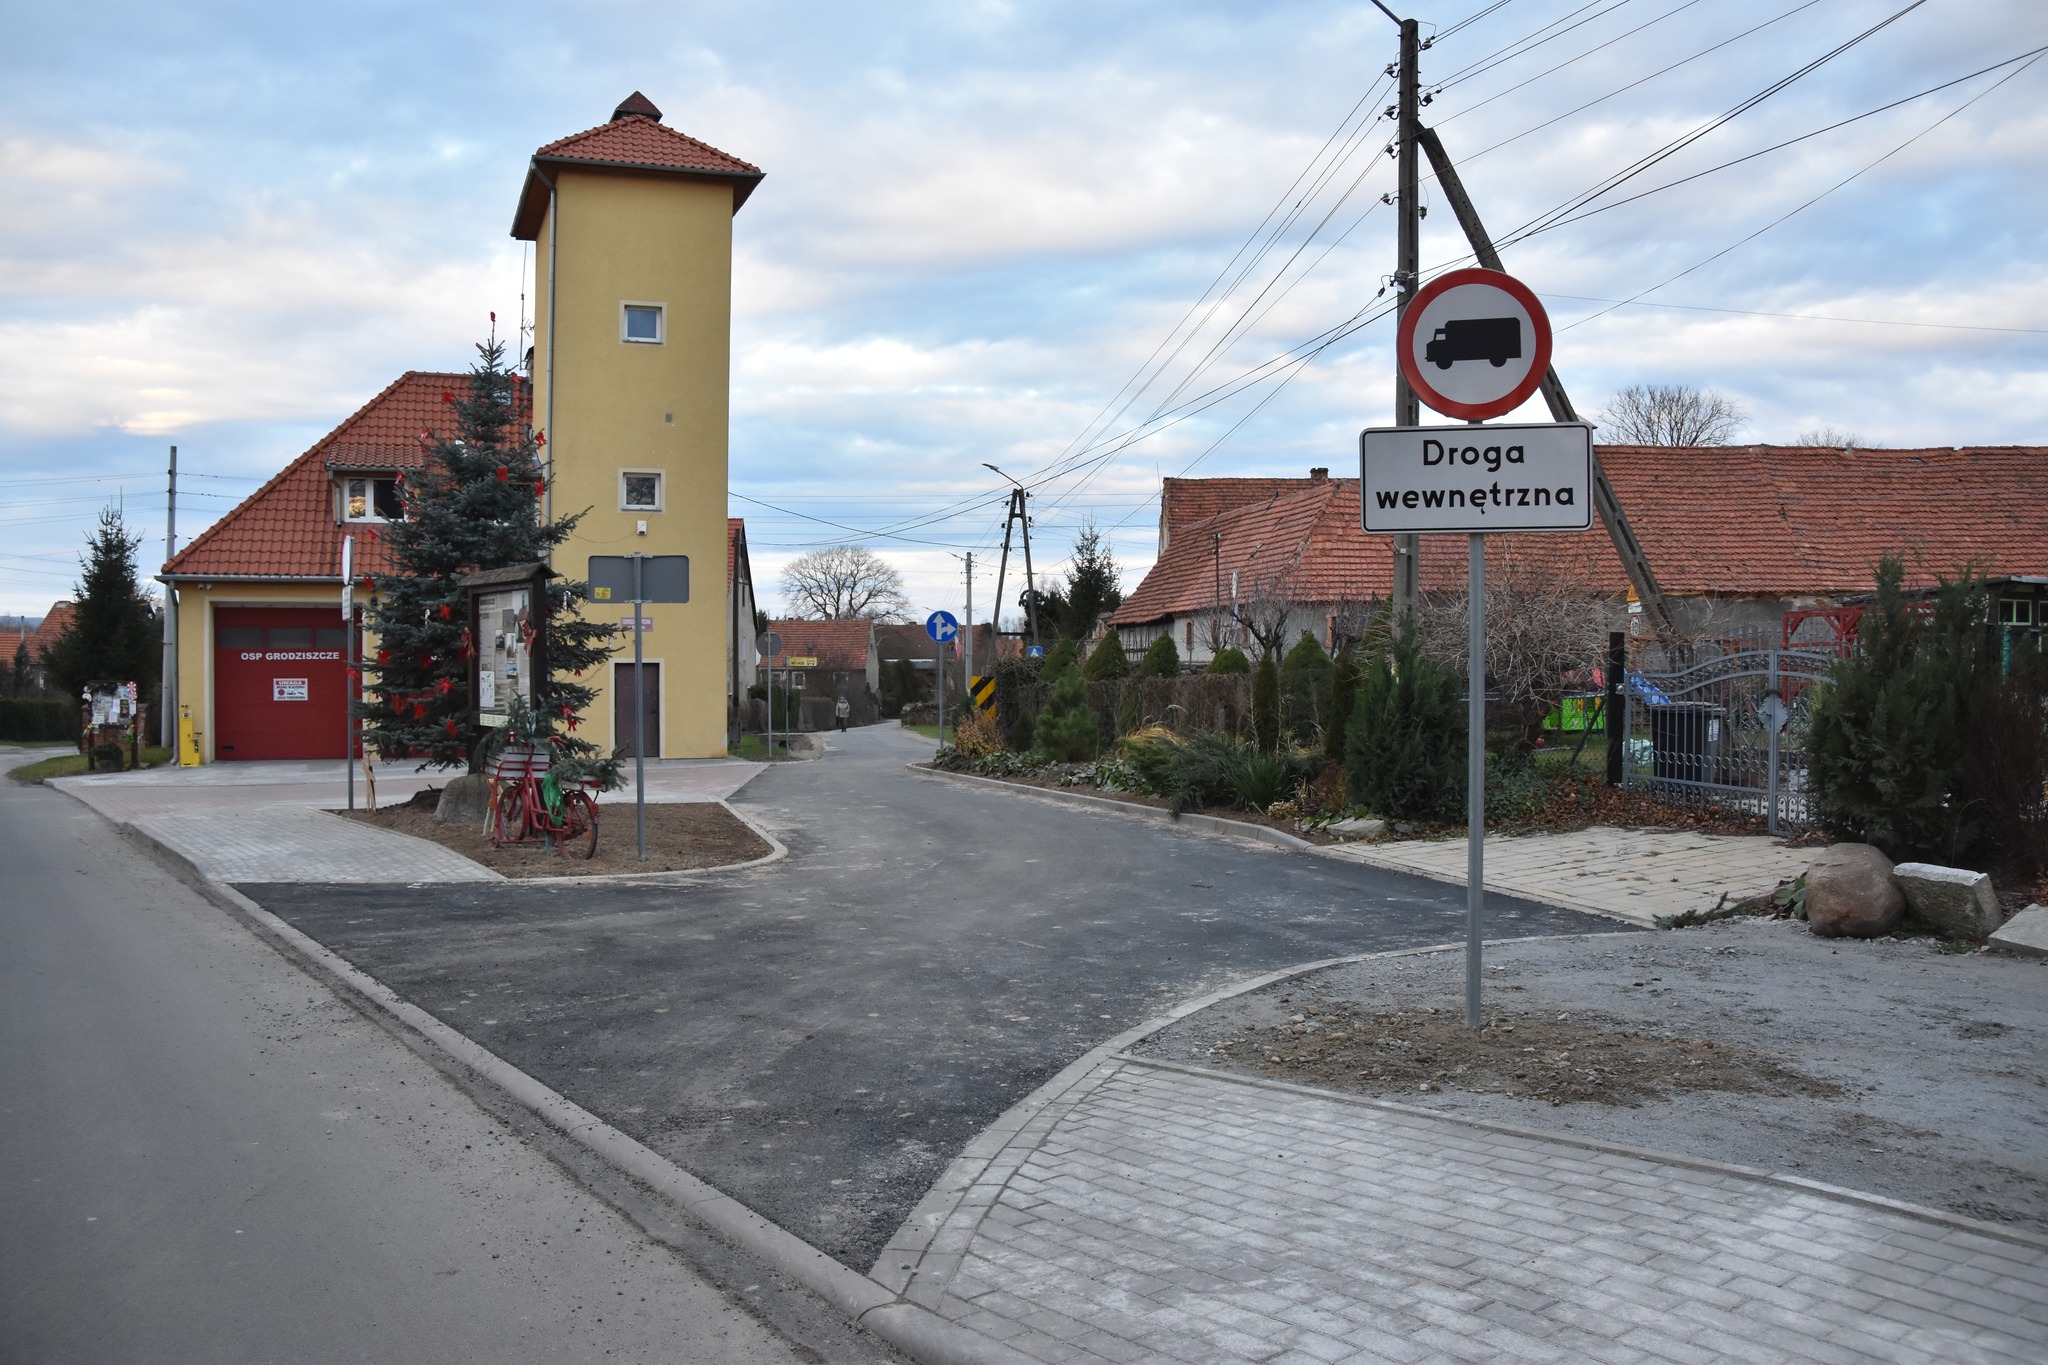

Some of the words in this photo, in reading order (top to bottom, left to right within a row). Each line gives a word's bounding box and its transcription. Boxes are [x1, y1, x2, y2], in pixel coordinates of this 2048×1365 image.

[1423, 440, 1525, 472] Droga
[1376, 481, 1575, 514] wewnętrzna
[241, 652, 262, 660] OSP
[265, 652, 340, 660] GRODZISZCZE
